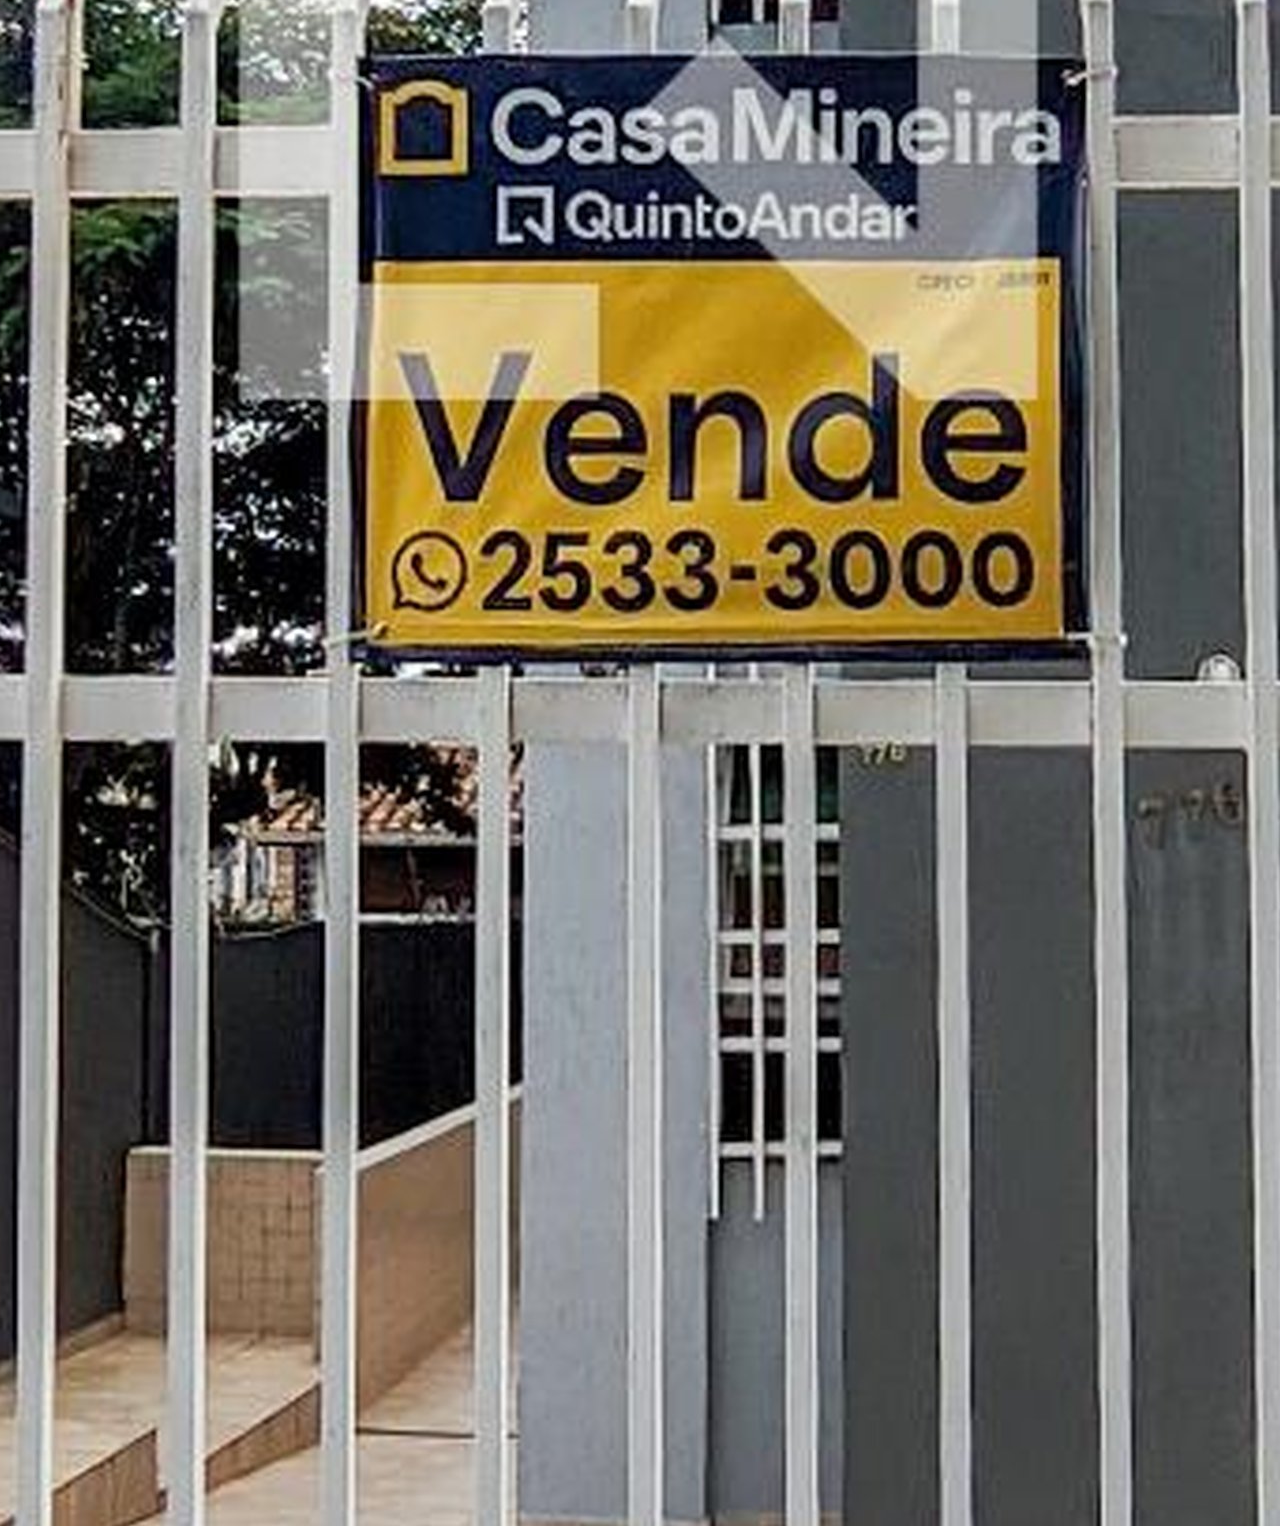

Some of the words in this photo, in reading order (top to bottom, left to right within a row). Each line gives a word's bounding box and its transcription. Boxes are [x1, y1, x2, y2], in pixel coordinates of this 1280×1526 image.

[564, 190, 918, 242] QuintoAndar
[400, 352, 1028, 504] Vende
[480, 530, 1035, 612] 2533-3000
